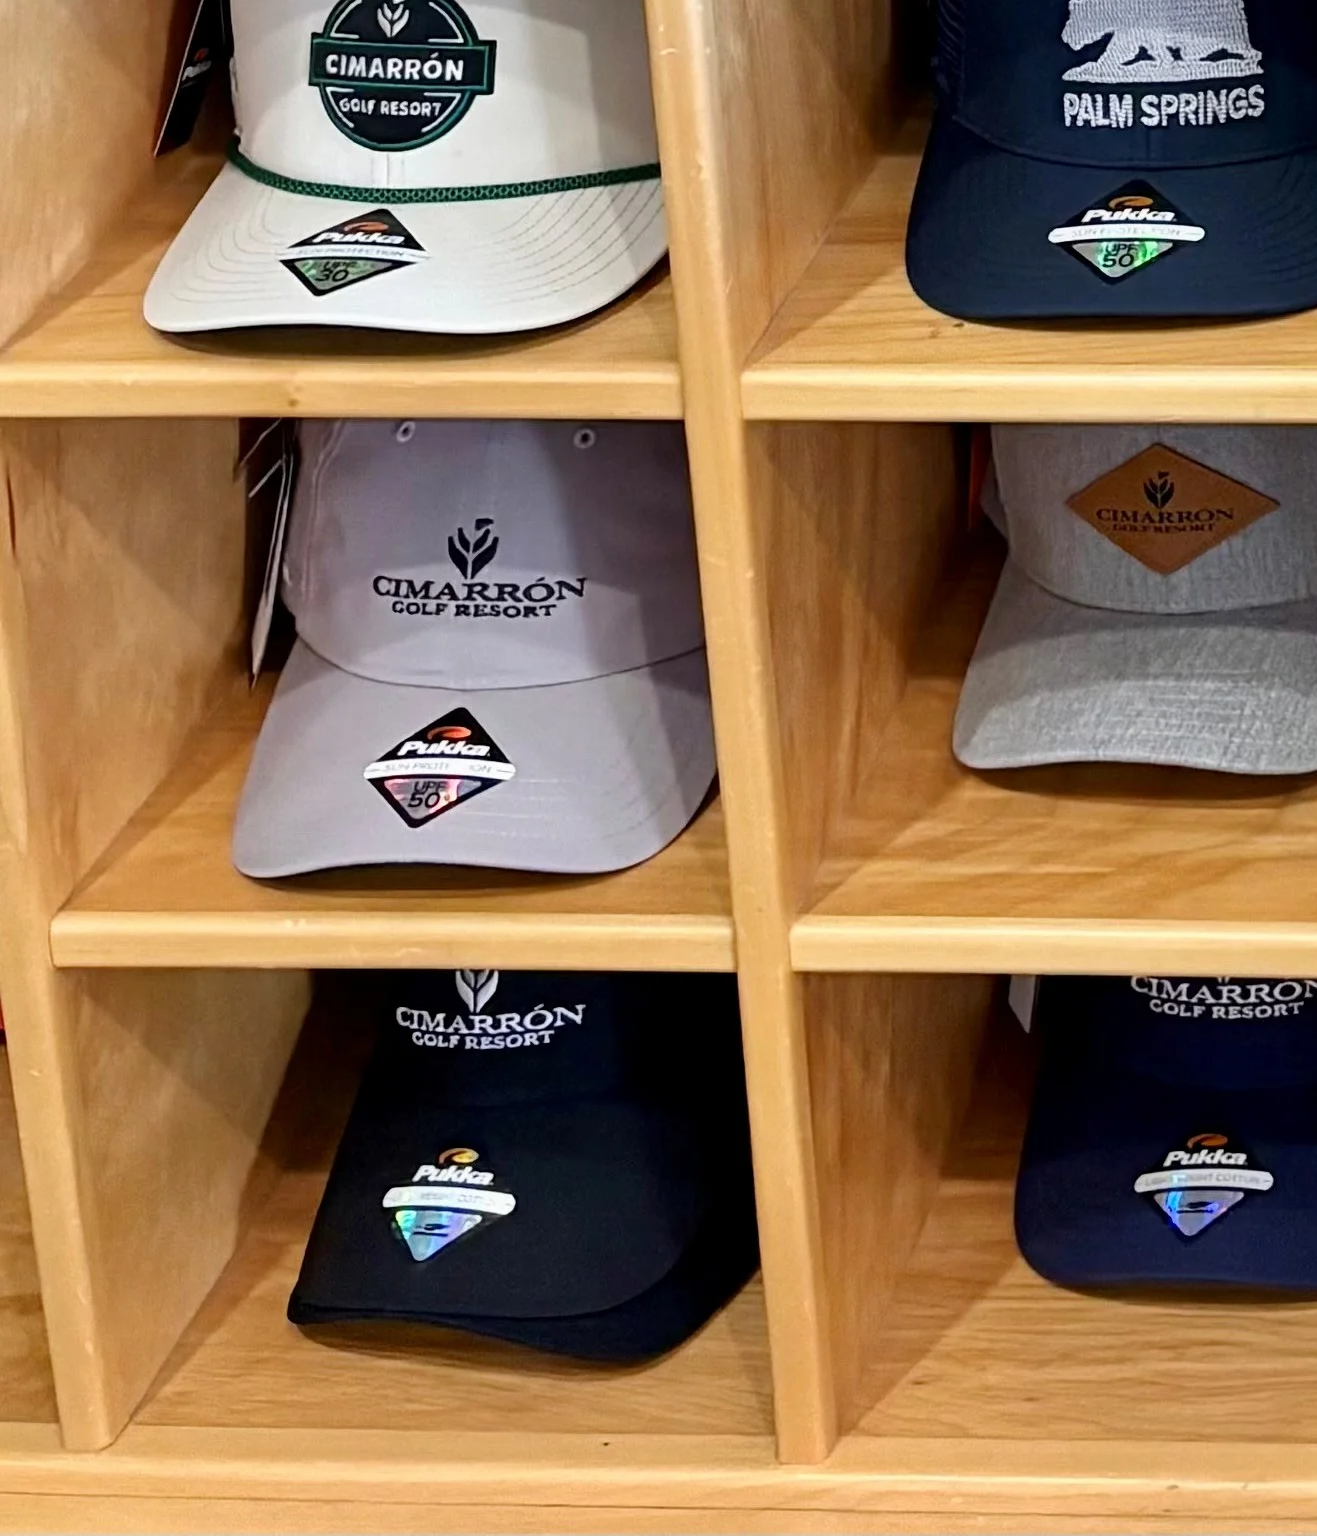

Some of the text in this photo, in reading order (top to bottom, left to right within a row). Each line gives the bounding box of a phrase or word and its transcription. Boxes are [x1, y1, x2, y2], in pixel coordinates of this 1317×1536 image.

[325, 51, 465, 82] CIMARRÓN
[338, 96, 442, 118] GOLF RESORT
[1063, 84, 1266, 128] PALM SPRINGS
[1080, 209, 1176, 223] Pukka
[312, 232, 405, 245] Pukka
[1103, 253, 1135, 268] 50
[372, 573, 587, 604] CIMARRÓN
[392, 599, 557, 619] GOLF RESORT
[396, 740, 491, 757] Pukka
[413, 781, 447, 793] UPF
[408, 792, 441, 807] 50
[395, 1002, 586, 1034] CIMARRÓN
[1150, 1000, 1305, 1020] GOLF RESORT
[410, 1030, 555, 1051] GOLF RESORT
[1163, 1149, 1247, 1167] Pukka
[412, 1165, 495, 1186] Pukka
